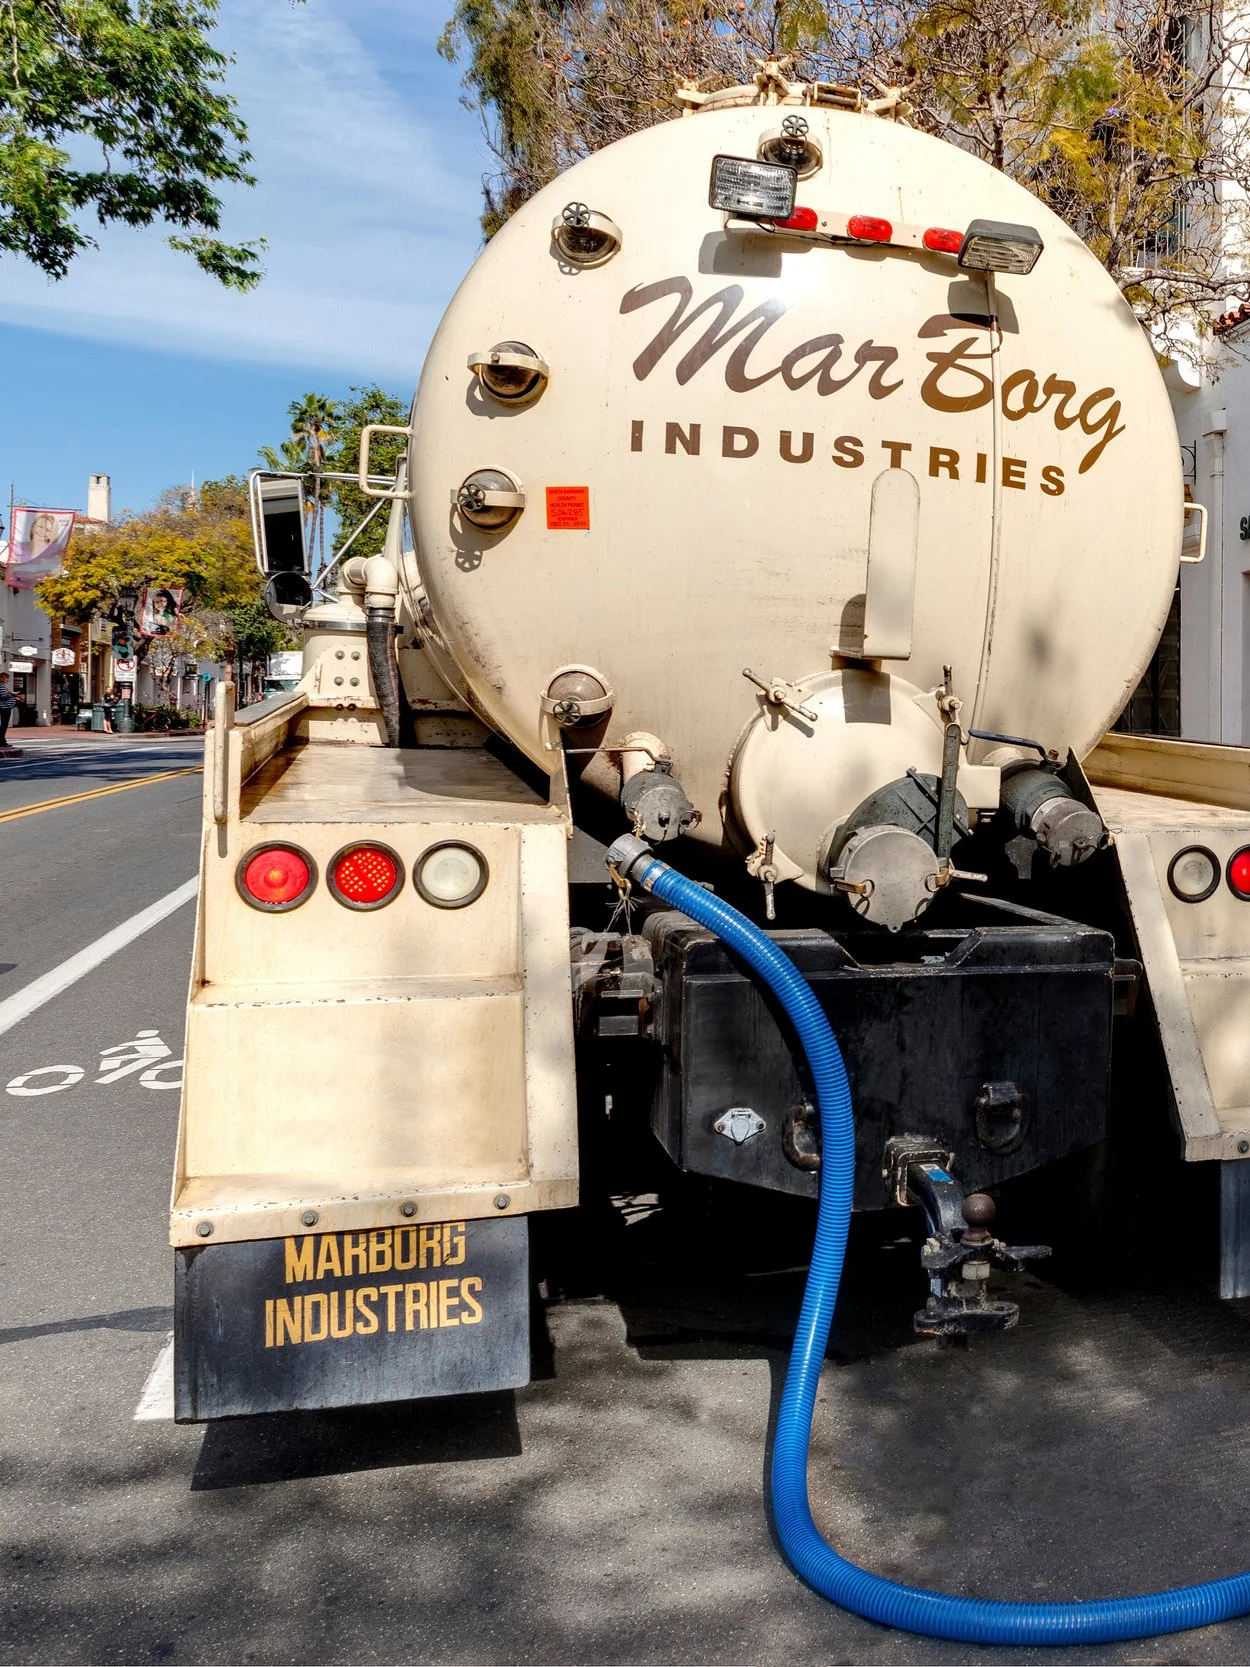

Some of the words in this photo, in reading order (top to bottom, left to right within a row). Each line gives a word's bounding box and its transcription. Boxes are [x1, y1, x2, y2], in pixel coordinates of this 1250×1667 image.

[630, 420, 1066, 496] INDUSTRIES
[284, 1221, 466, 1284] MARBORG
[264, 1276, 484, 1348] INDUSTRIES
